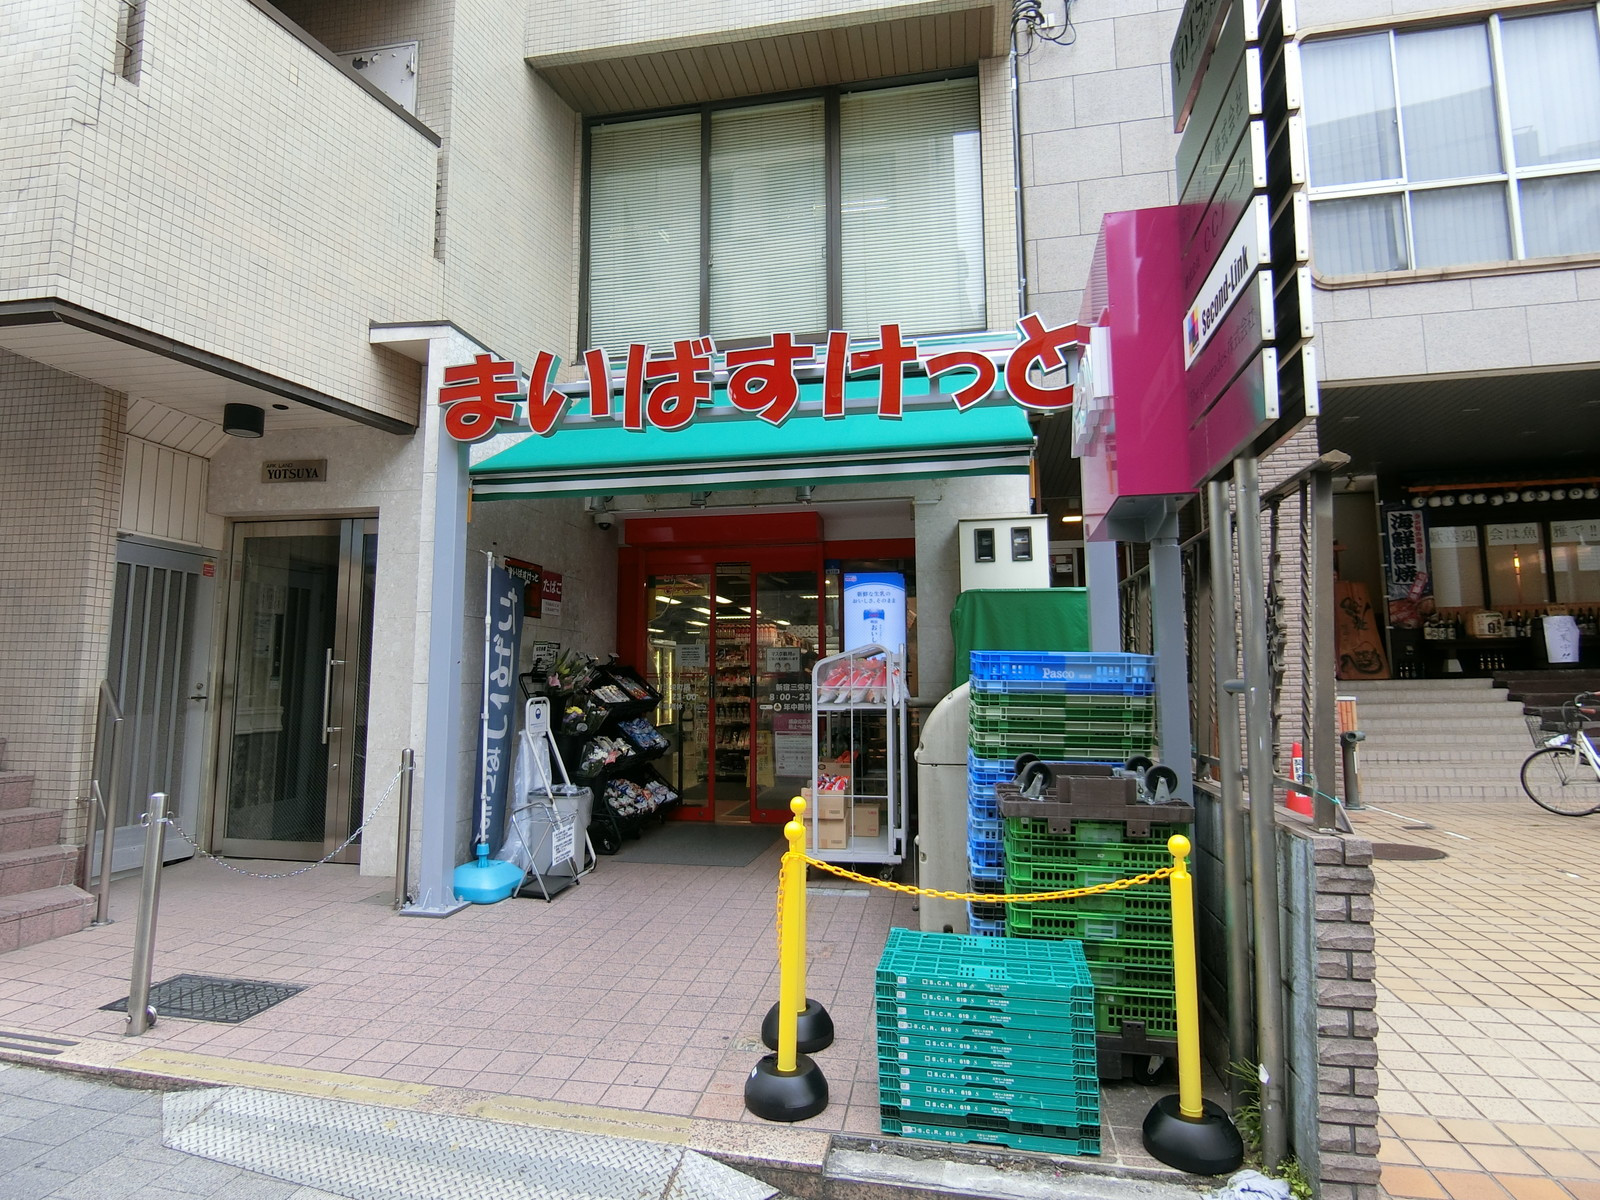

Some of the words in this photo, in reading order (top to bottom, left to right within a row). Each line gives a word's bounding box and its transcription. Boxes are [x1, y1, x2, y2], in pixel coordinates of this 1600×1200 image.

[1201, 244, 1249, 336] Second-Link
[438, 312, 1088, 442] まいばすけっと
[267, 467, 319, 480] YOTSUYA
[1489, 525, 1537, 541] 会は魚
[1390, 513, 1417, 582] 海鮮網焼
[542, 578, 562, 595] たばこ
[1042, 667, 1075, 679] Pasco
[783, 703, 812, 711] 年中無休
